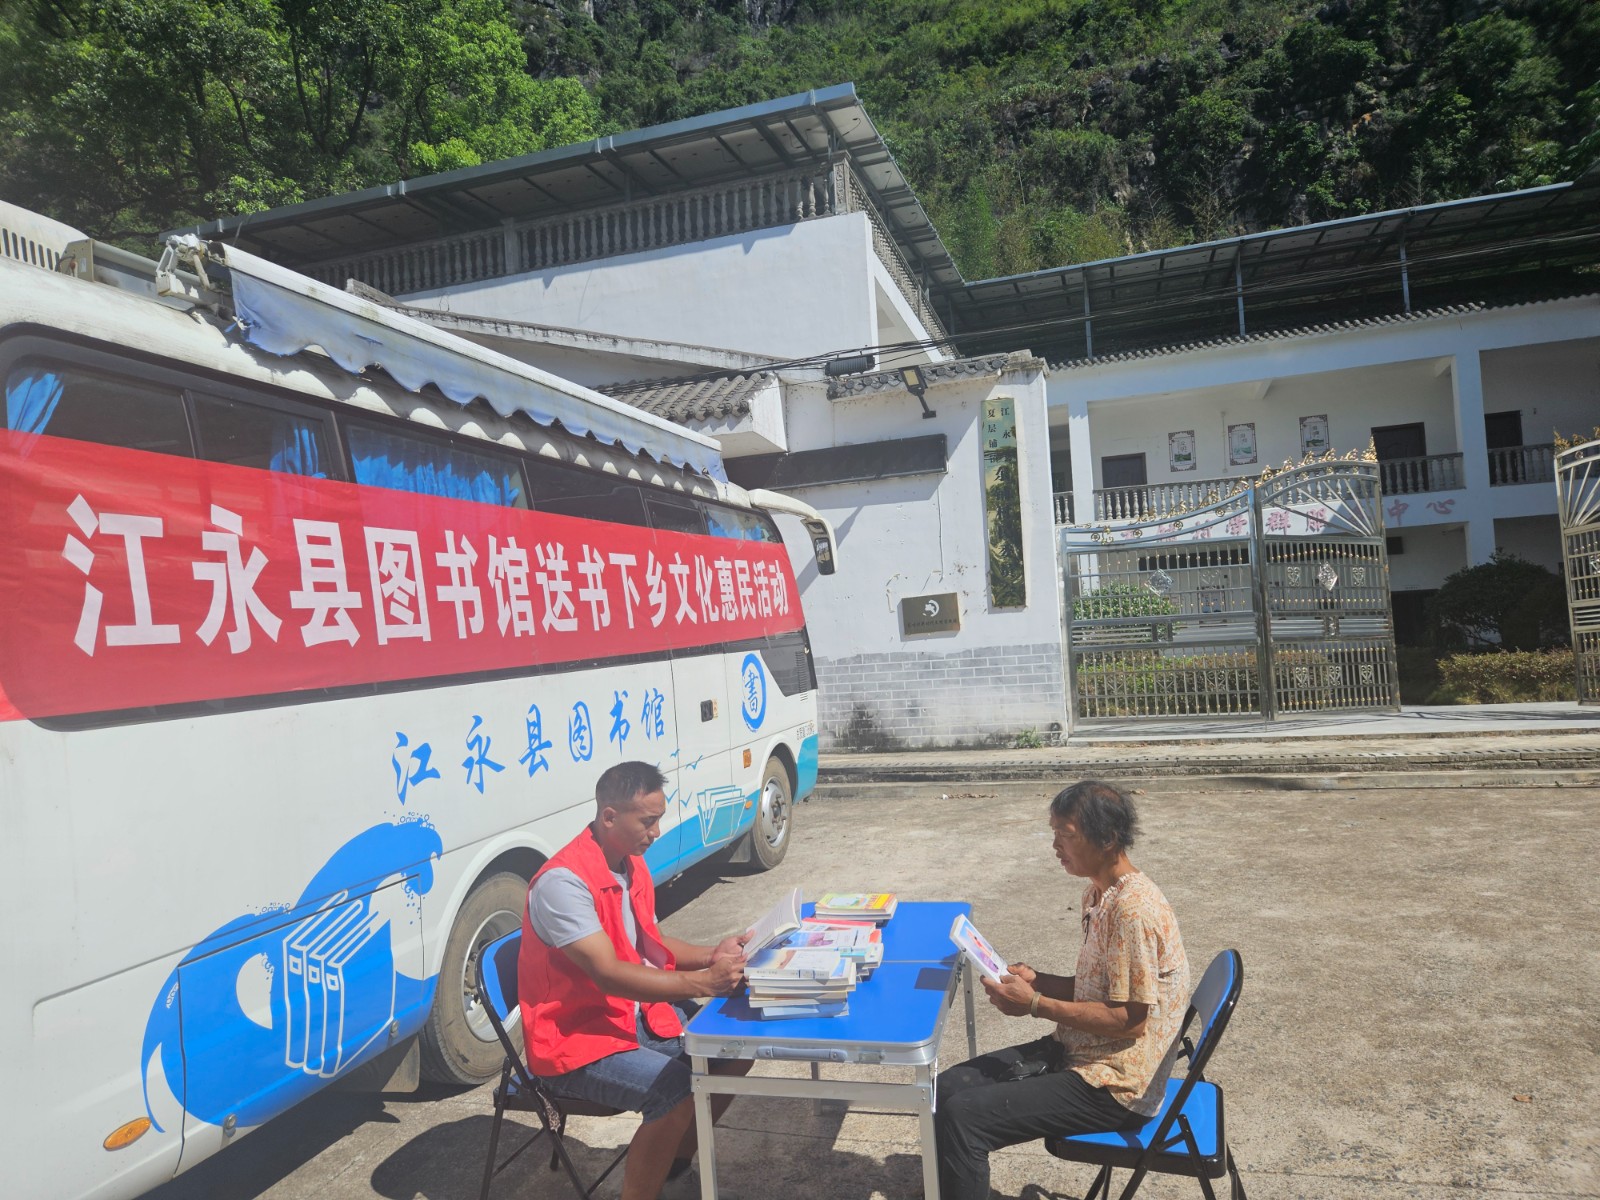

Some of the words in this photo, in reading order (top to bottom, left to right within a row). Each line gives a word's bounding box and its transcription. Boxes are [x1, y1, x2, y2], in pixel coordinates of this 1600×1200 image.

[61, 493, 789, 657] 江永县图书馆送书下乡文化惠民活动
[391, 688, 665, 806] 江永县图书馆
